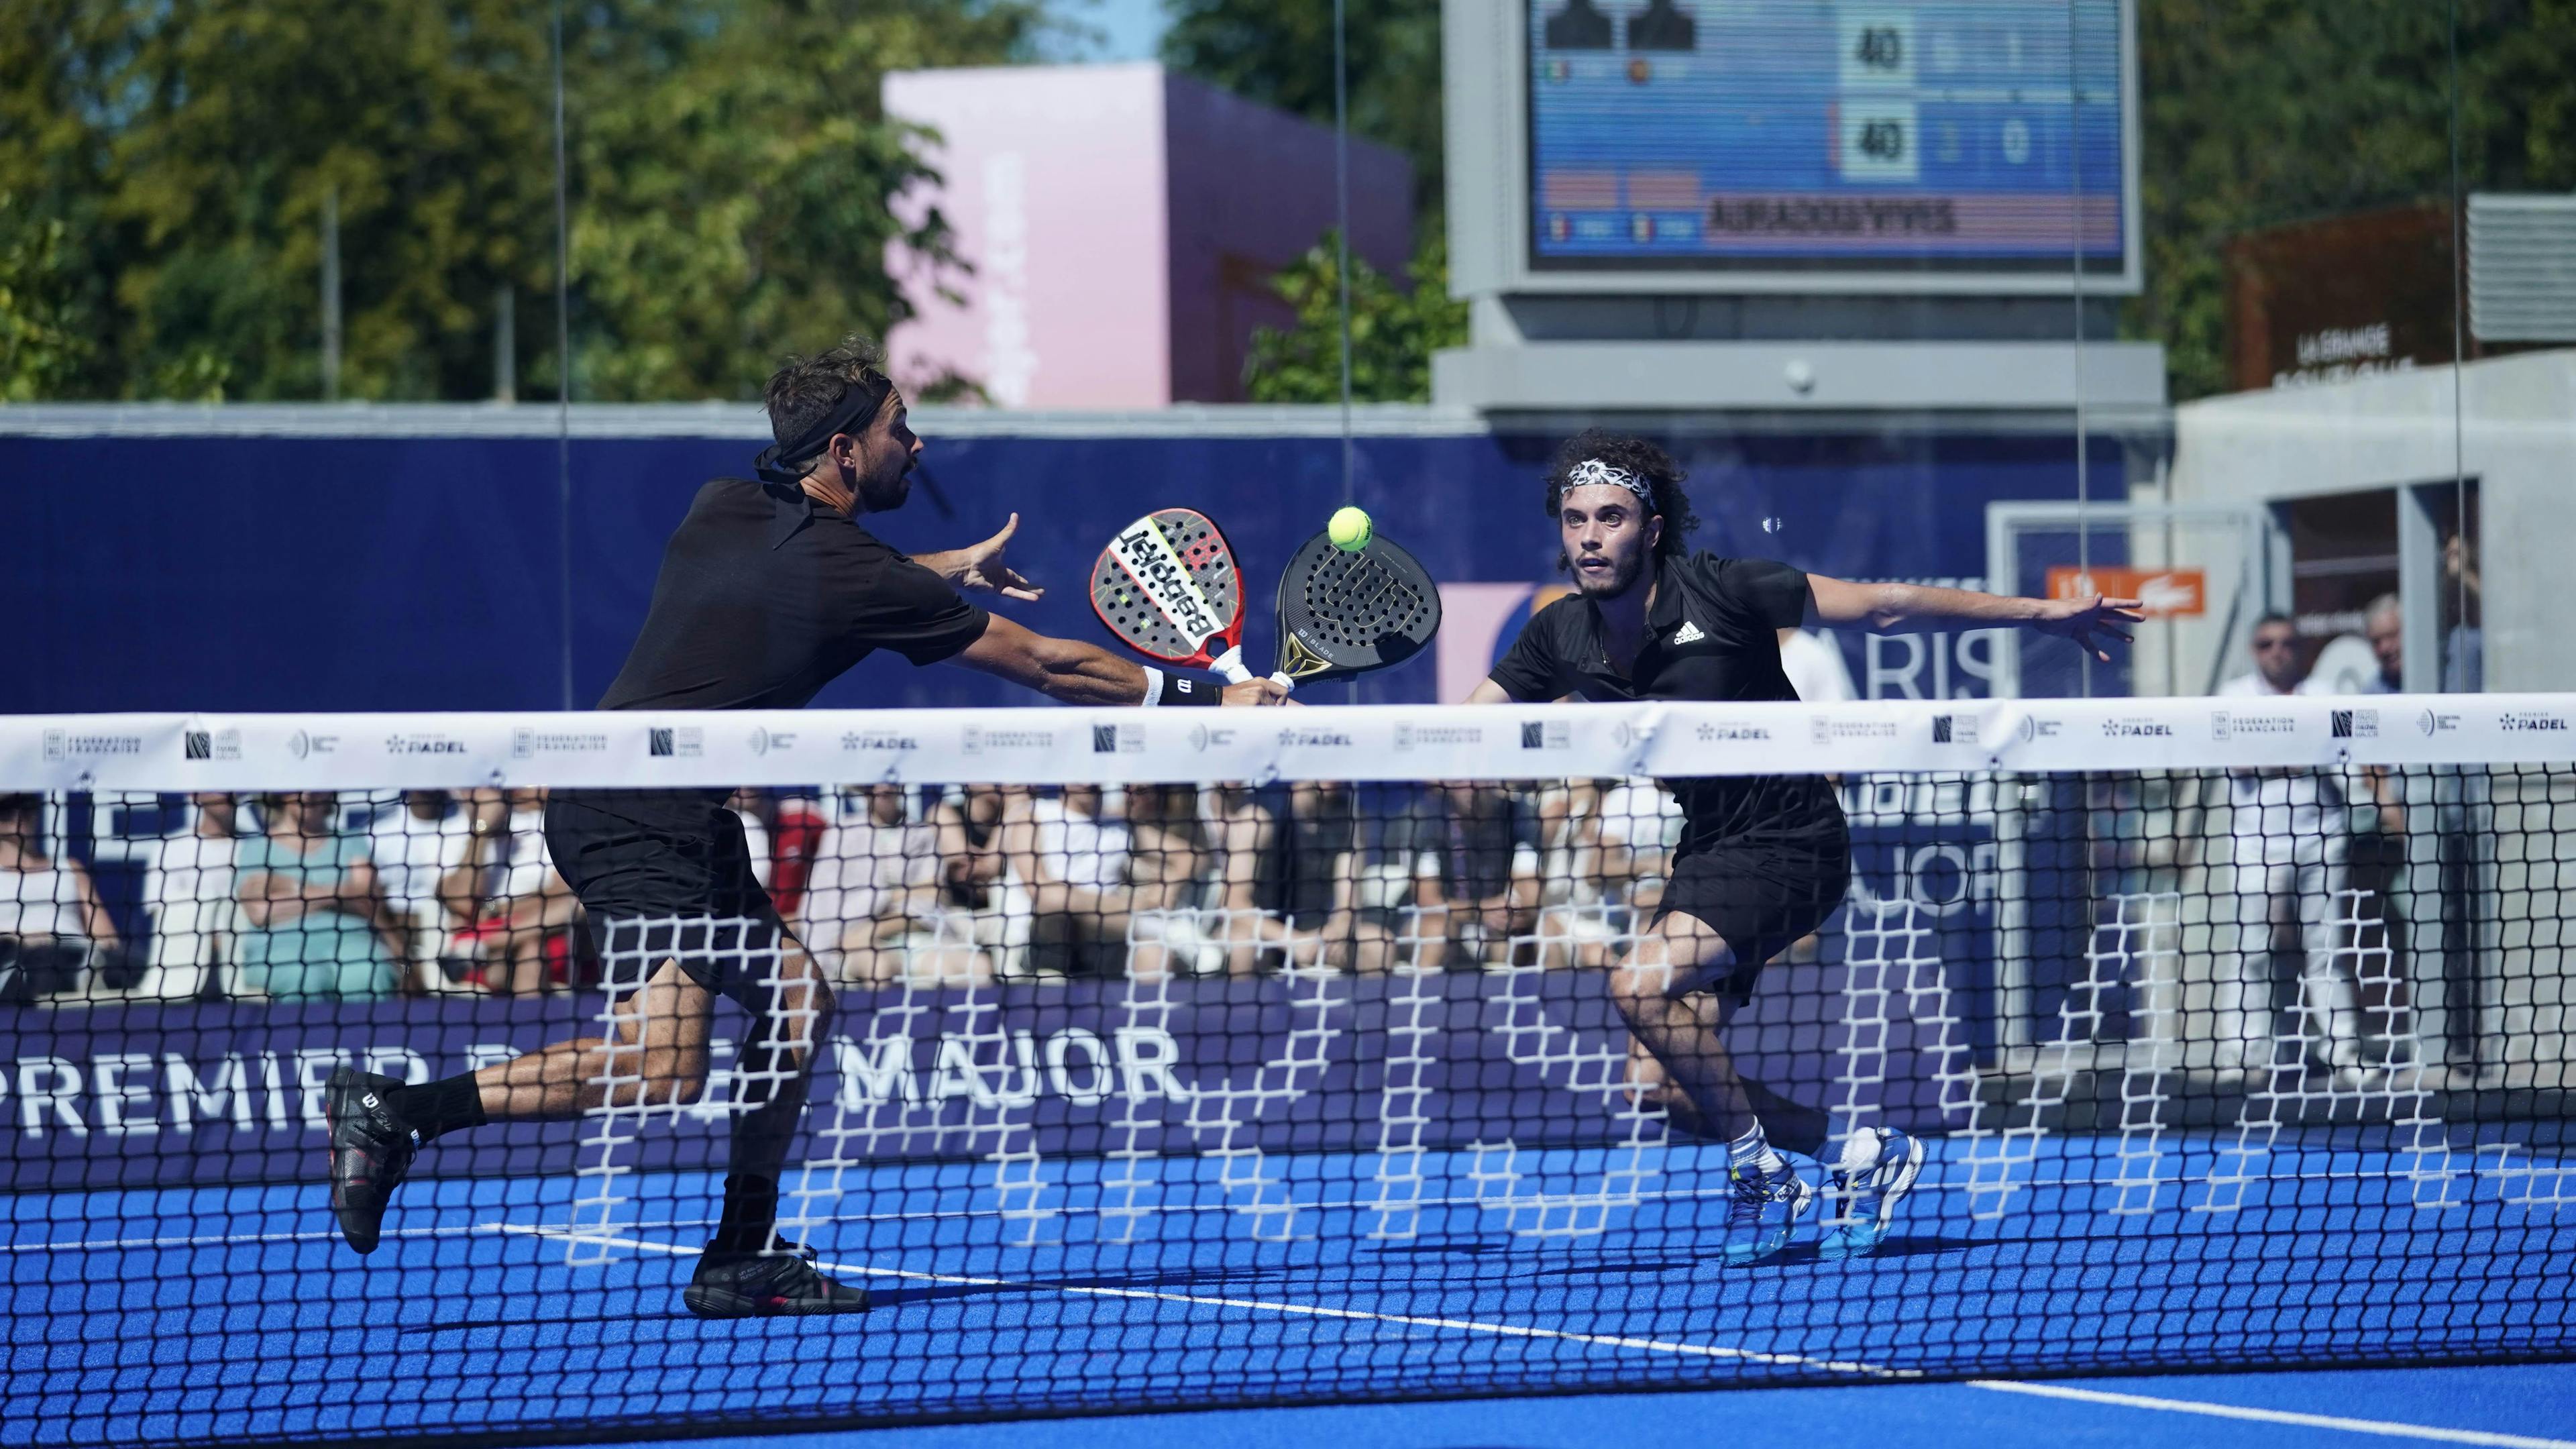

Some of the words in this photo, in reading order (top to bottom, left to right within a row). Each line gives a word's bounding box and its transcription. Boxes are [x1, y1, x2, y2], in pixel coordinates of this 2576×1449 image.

[1857, 28, 1901, 68] 40
[1860, 122, 1902, 160] 40
[2003, 119, 2030, 164] 0
[1673, 631, 1705, 645] adidas
[1310, 638, 1334, 660] BLADE
[1717, 729, 1771, 739] PADEL
[2121, 724, 2173, 736] PADEL
[2518, 719, 2568, 731] PADEL
[833, 1026, 1191, 1115] MAJOR
